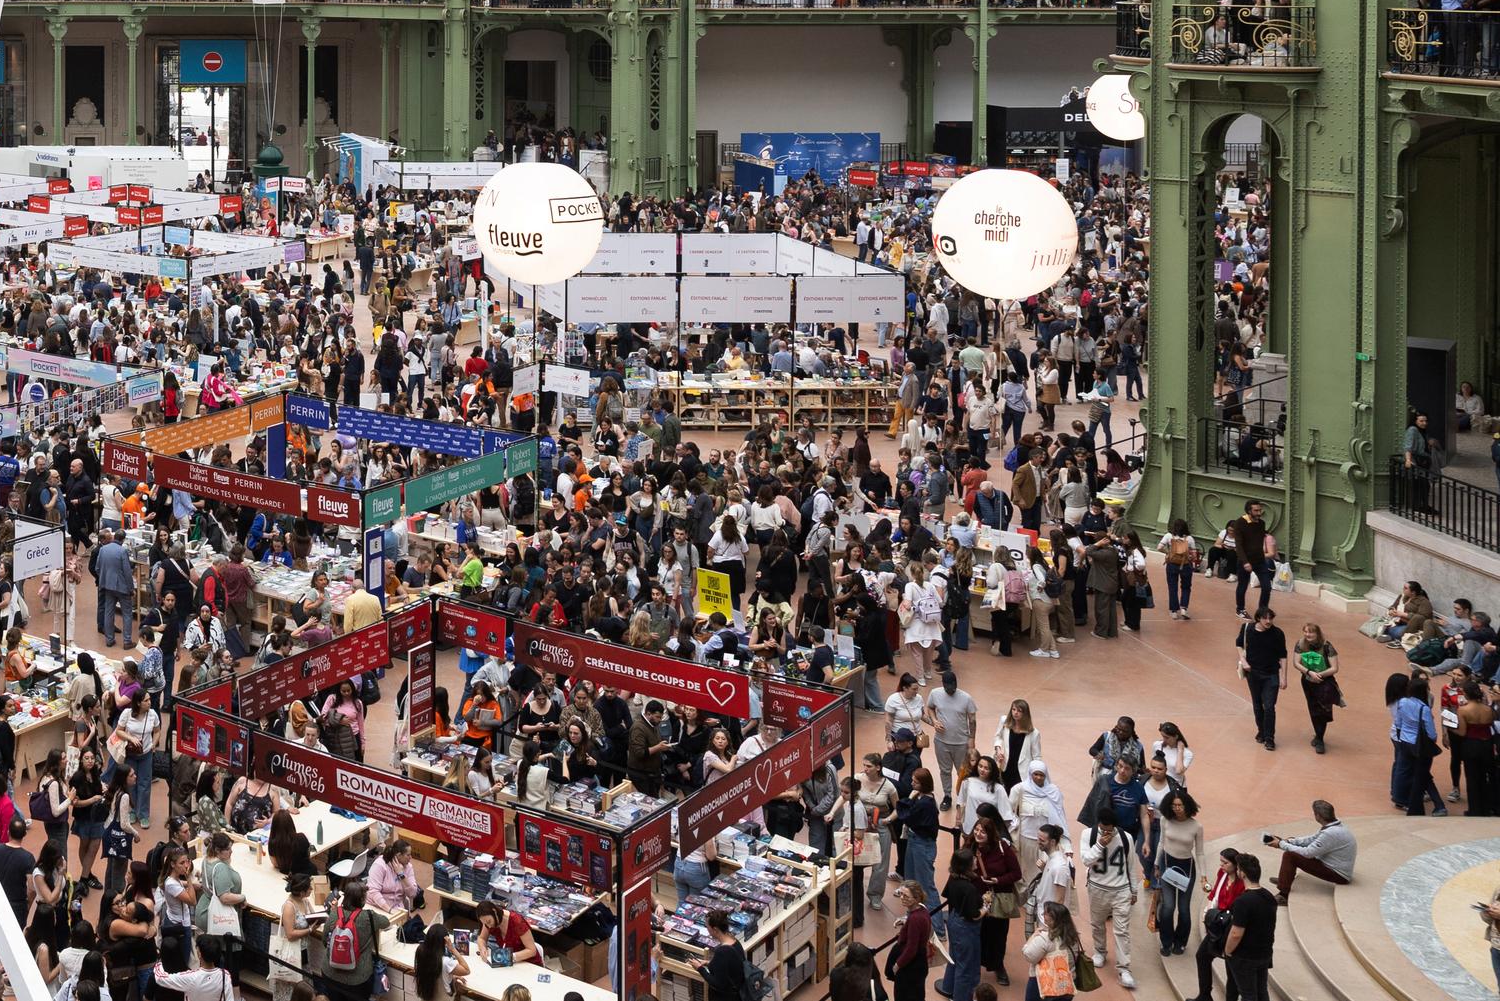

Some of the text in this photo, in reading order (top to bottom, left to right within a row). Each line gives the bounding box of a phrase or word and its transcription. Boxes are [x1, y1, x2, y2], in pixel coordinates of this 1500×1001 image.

[995, 204, 1003, 214] le
[974, 210, 1021, 228] cherche
[488, 223, 543, 249] fleuve
[984, 227, 1009, 243] midi
[33, 363, 58, 374] POCKET
[134, 385, 156, 396] POCKET
[254, 405, 281, 421] PERRIN
[290, 404, 326, 421] PERRIN
[113, 448, 139, 464] Robert
[512, 448, 531, 461] Robert
[111, 459, 139, 476] Laffont
[189, 464, 208, 476] Robert
[462, 464, 481, 476] PERRIN
[511, 460, 531, 473] Laffont
[189, 472, 208, 483] Laffont
[213, 471, 230, 482] fleuve
[235, 478, 263, 491] PERRIN
[167, 477, 193, 490] REGARDE
[194, 483, 202, 492] DE
[203, 485, 219, 496] TOUS
[220, 489, 231, 498] TES
[233, 491, 251, 503] YEUX,
[252, 496, 281, 508] REGARDE
[317, 494, 349, 514] fleuve
[372, 496, 394, 513] fleuve
[26, 545, 50, 560] Grèce
[704, 595, 721, 605] OFFERT
[529, 640, 569, 660] plumes
[542, 648, 575, 668] du Web
[585, 654, 701, 692] CRÉATEUR DE COUPS DE
[768, 689, 813, 703] COLLECTIONS UNIQUES
[271, 752, 318, 778] plumes
[286, 767, 325, 794] du Web
[687, 809, 702, 827] MON
[700, 791, 727, 819] PROCHAIN
[727, 781, 744, 803] COUP
[743, 777, 752, 791] DE
[784, 754, 793, 764] est
[792, 749, 800, 761] ici
[339, 773, 417, 809] ROMANCE
[428, 799, 489, 826] ROMANCE
[429, 809, 490, 834] DE L'IMAGINAIRE
[451, 836, 468, 846] Fantasy
